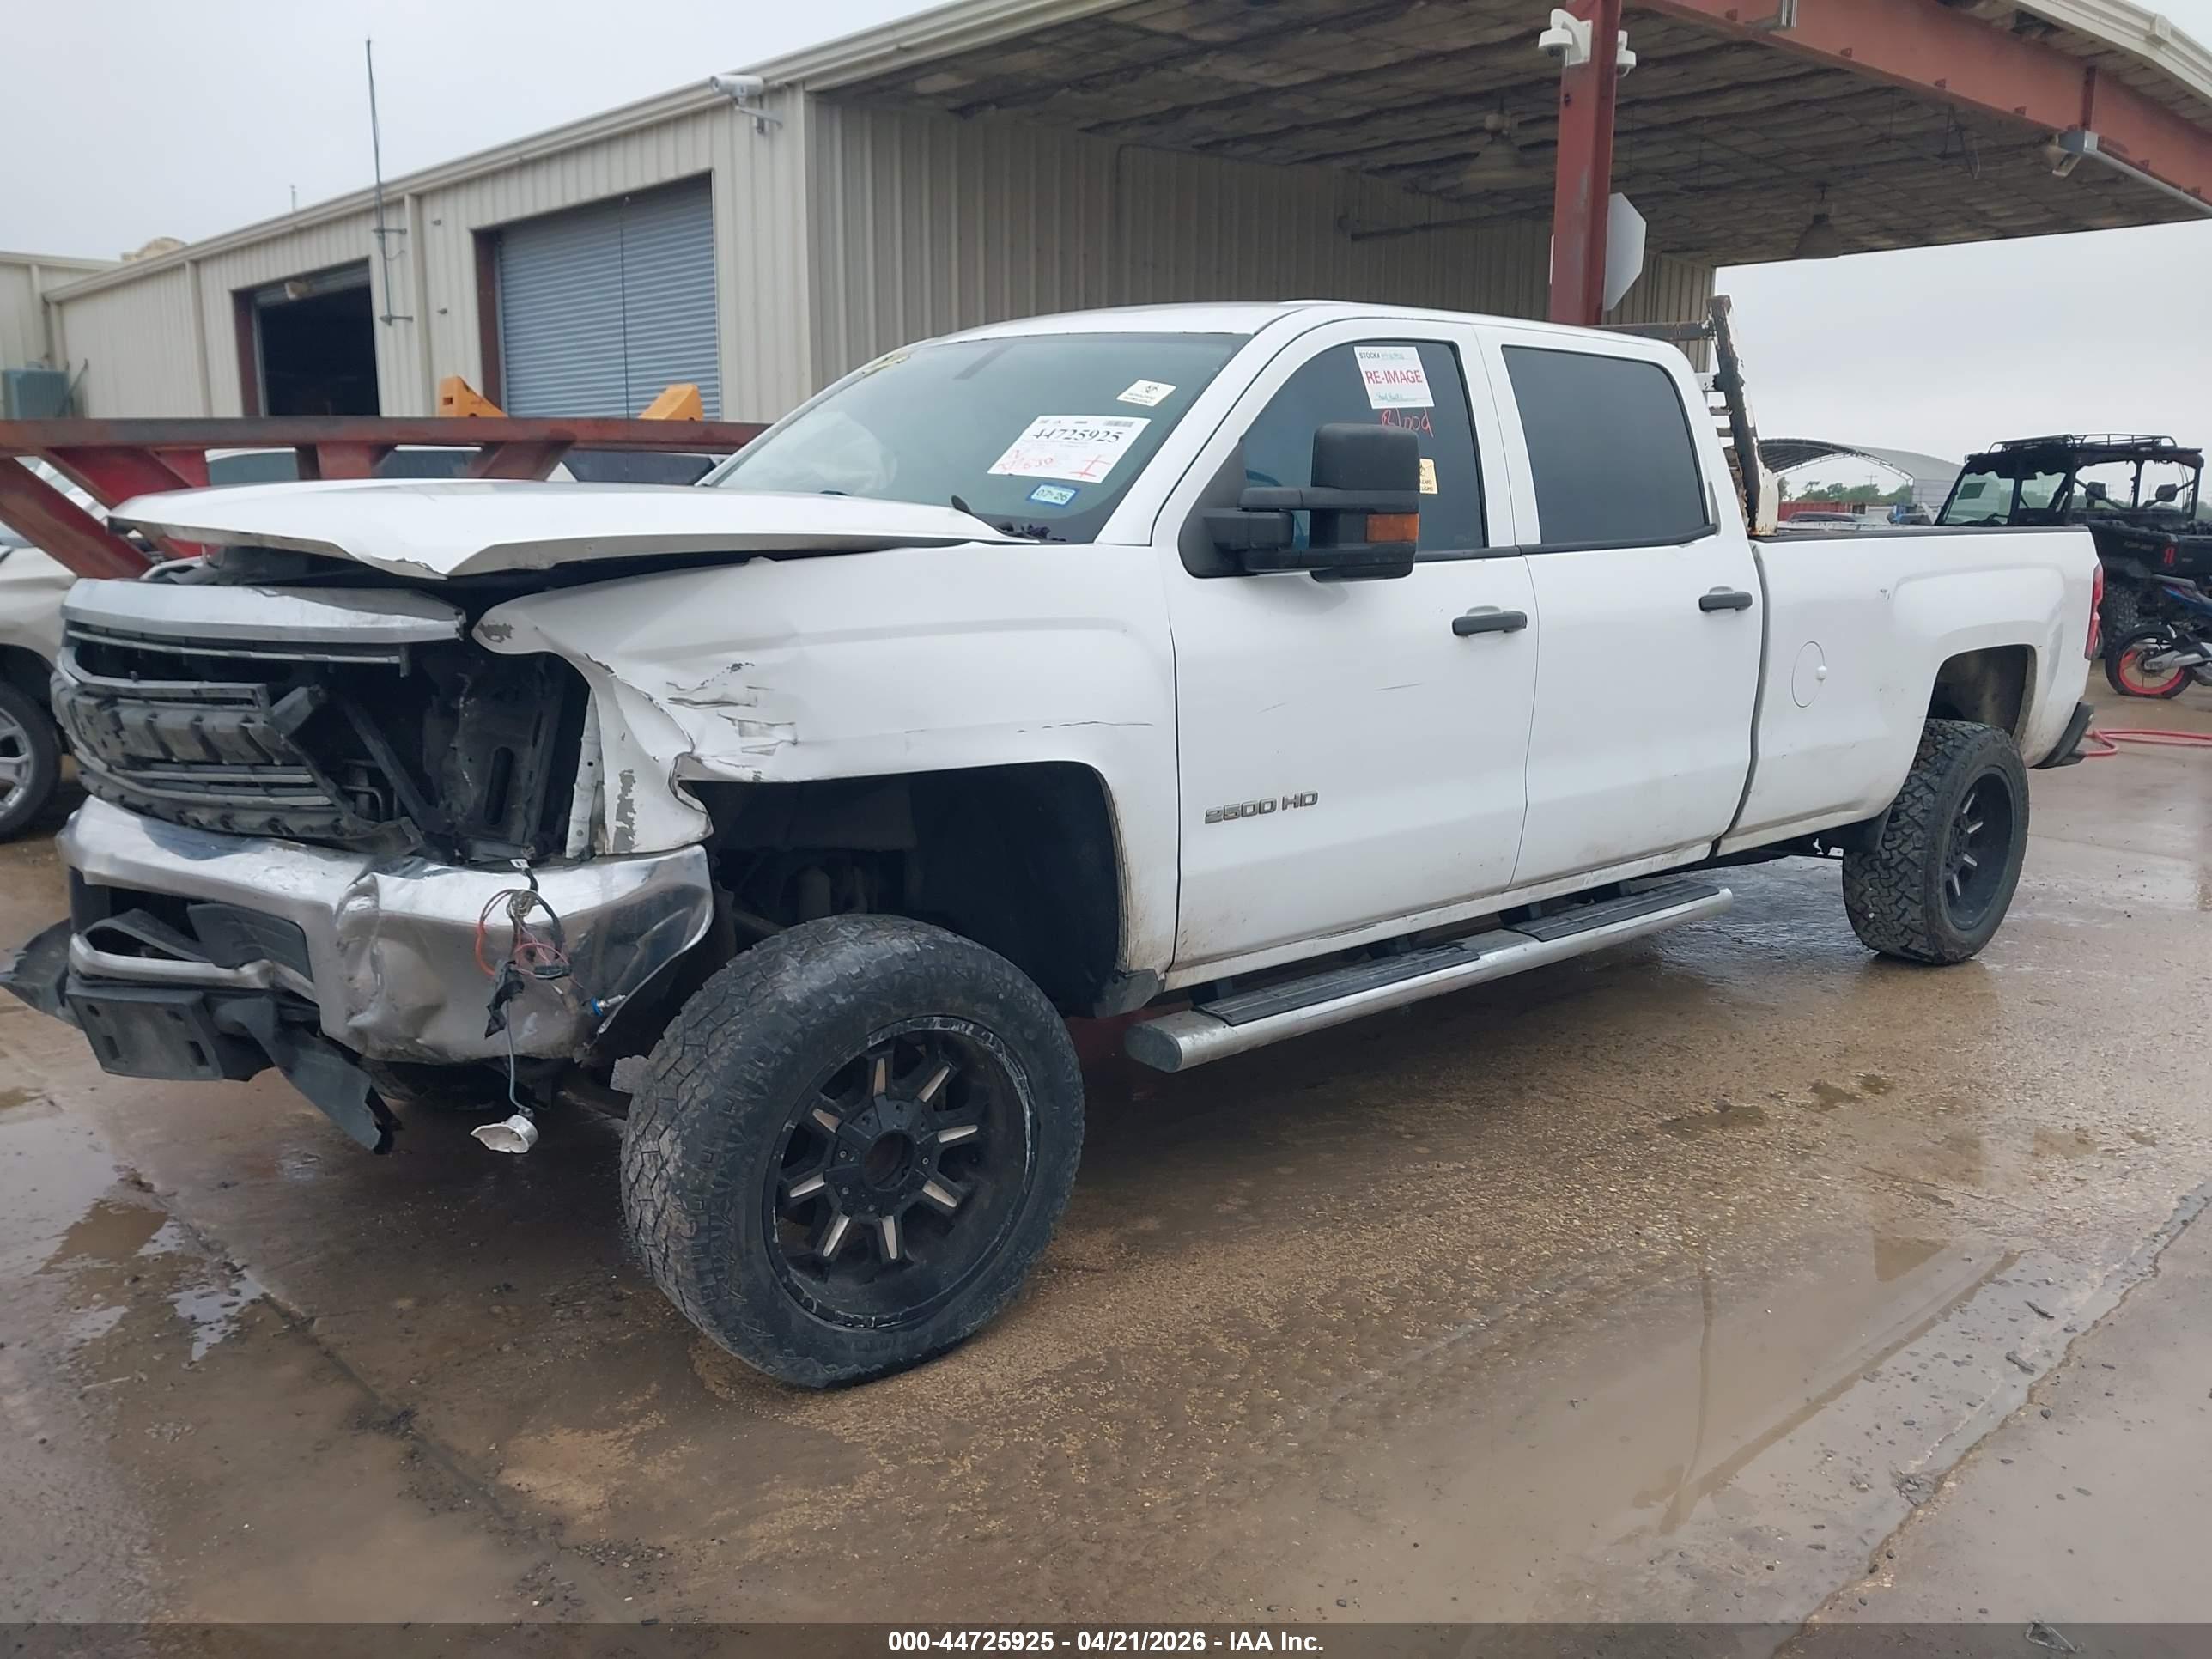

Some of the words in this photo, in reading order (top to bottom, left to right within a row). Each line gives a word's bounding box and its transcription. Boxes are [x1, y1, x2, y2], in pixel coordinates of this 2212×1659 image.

[1364, 369, 1423, 385] RE-IMAGE
[1033, 428, 1124, 443] 44725925
[1204, 798, 1278, 824] 2500
[1281, 790, 1319, 811] HD
